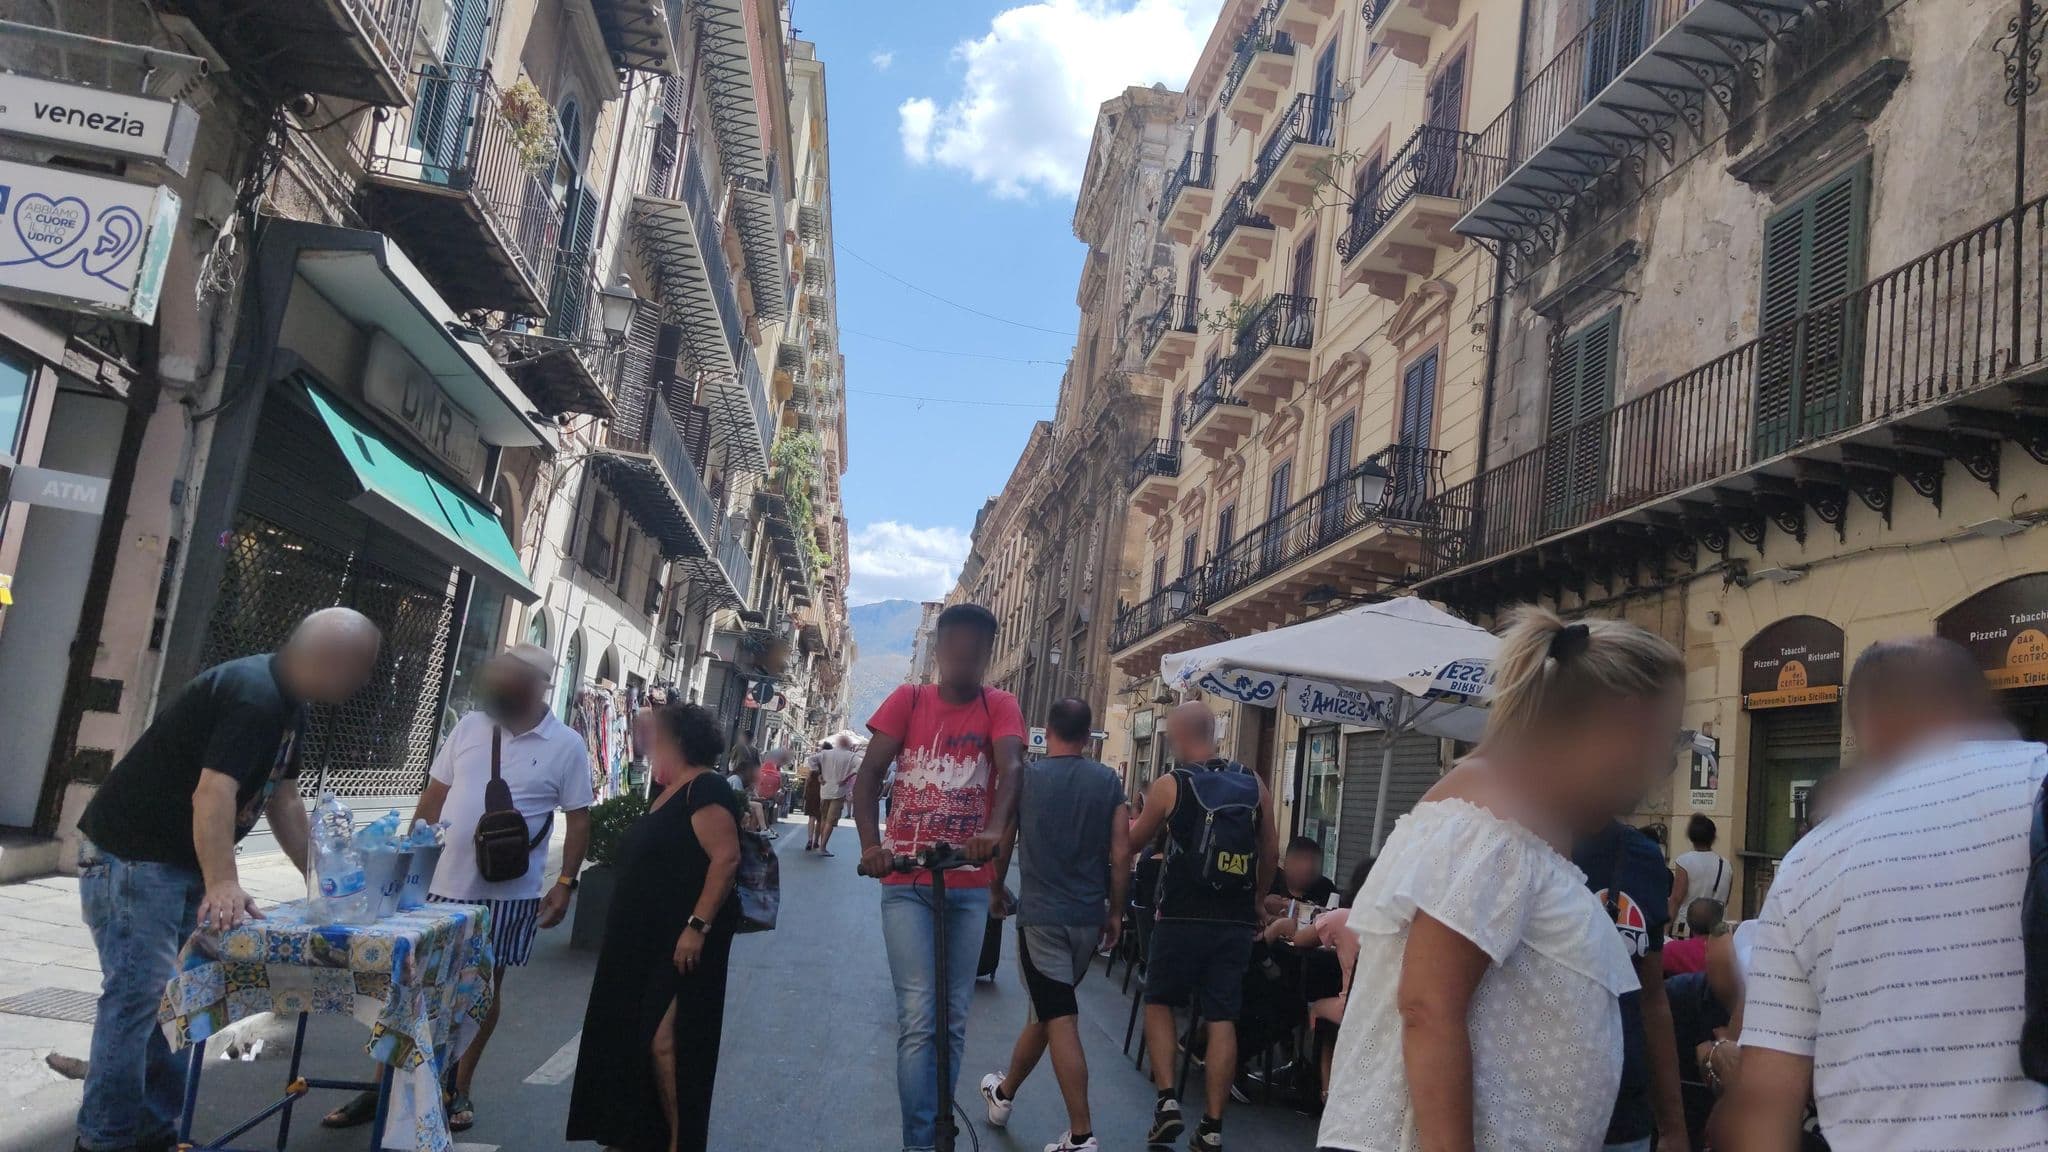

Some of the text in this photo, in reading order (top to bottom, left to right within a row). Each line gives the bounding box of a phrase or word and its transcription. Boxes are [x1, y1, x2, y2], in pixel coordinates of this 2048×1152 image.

[34, 101, 145, 138] venezia
[25, 203, 79, 219] ABBIAMO
[36, 214, 76, 229] CUORE
[29, 222, 66, 236] IL TUO
[27, 232, 63, 245] UDITO
[41, 480, 97, 502] ATM
[1970, 628, 2008, 642] Pizzeria
[2017, 635, 2034, 644] BAR
[1781, 645, 1806, 656] Tabacchi
[2030, 643, 2044, 652] del
[1754, 658, 1779, 668] Pizzeria
[1808, 651, 1840, 662] Ristorante
[1218, 852, 1249, 876] CAT
